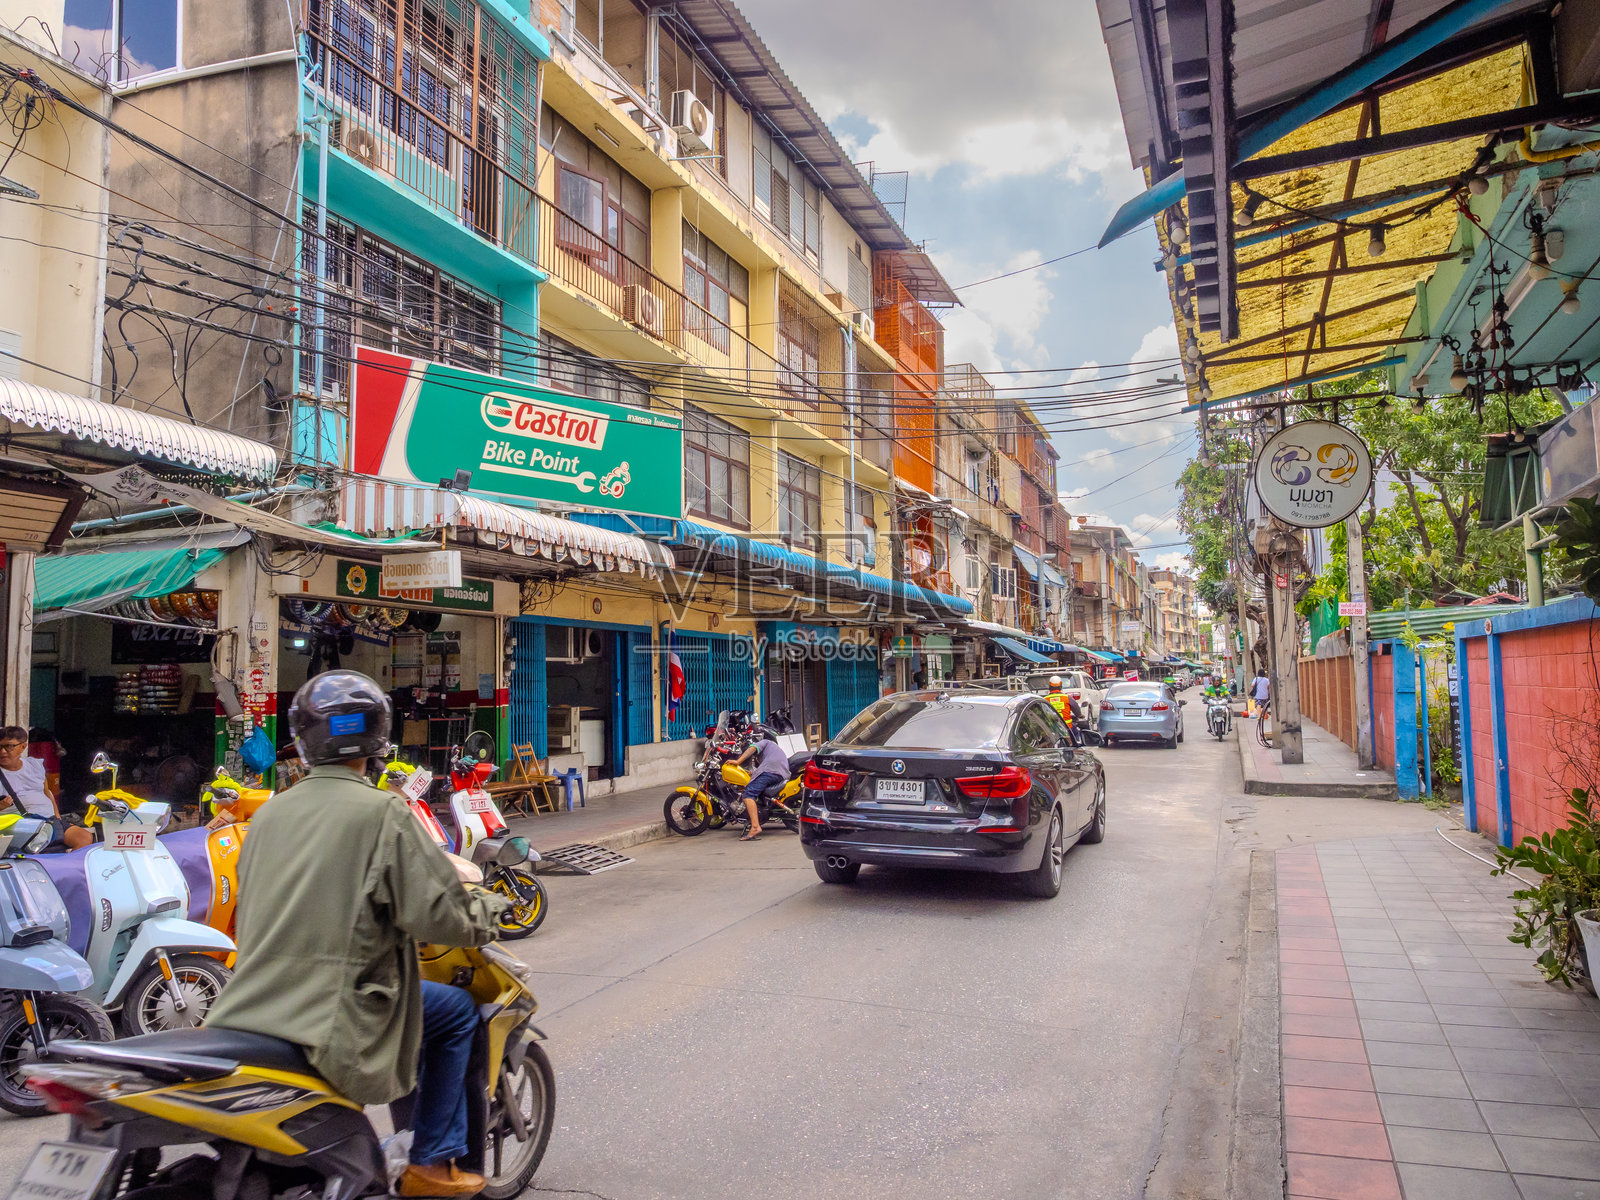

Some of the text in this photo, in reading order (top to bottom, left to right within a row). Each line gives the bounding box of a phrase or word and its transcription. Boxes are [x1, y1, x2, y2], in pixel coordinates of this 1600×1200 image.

[515, 403, 600, 444] Castrol
[482, 440, 580, 474] Bike Point
[1290, 488, 1334, 507] มุมชา
[822, 759, 841, 767] GT
[900, 781, 923, 793] 4301
[117, 834, 144, 846] ขาย
